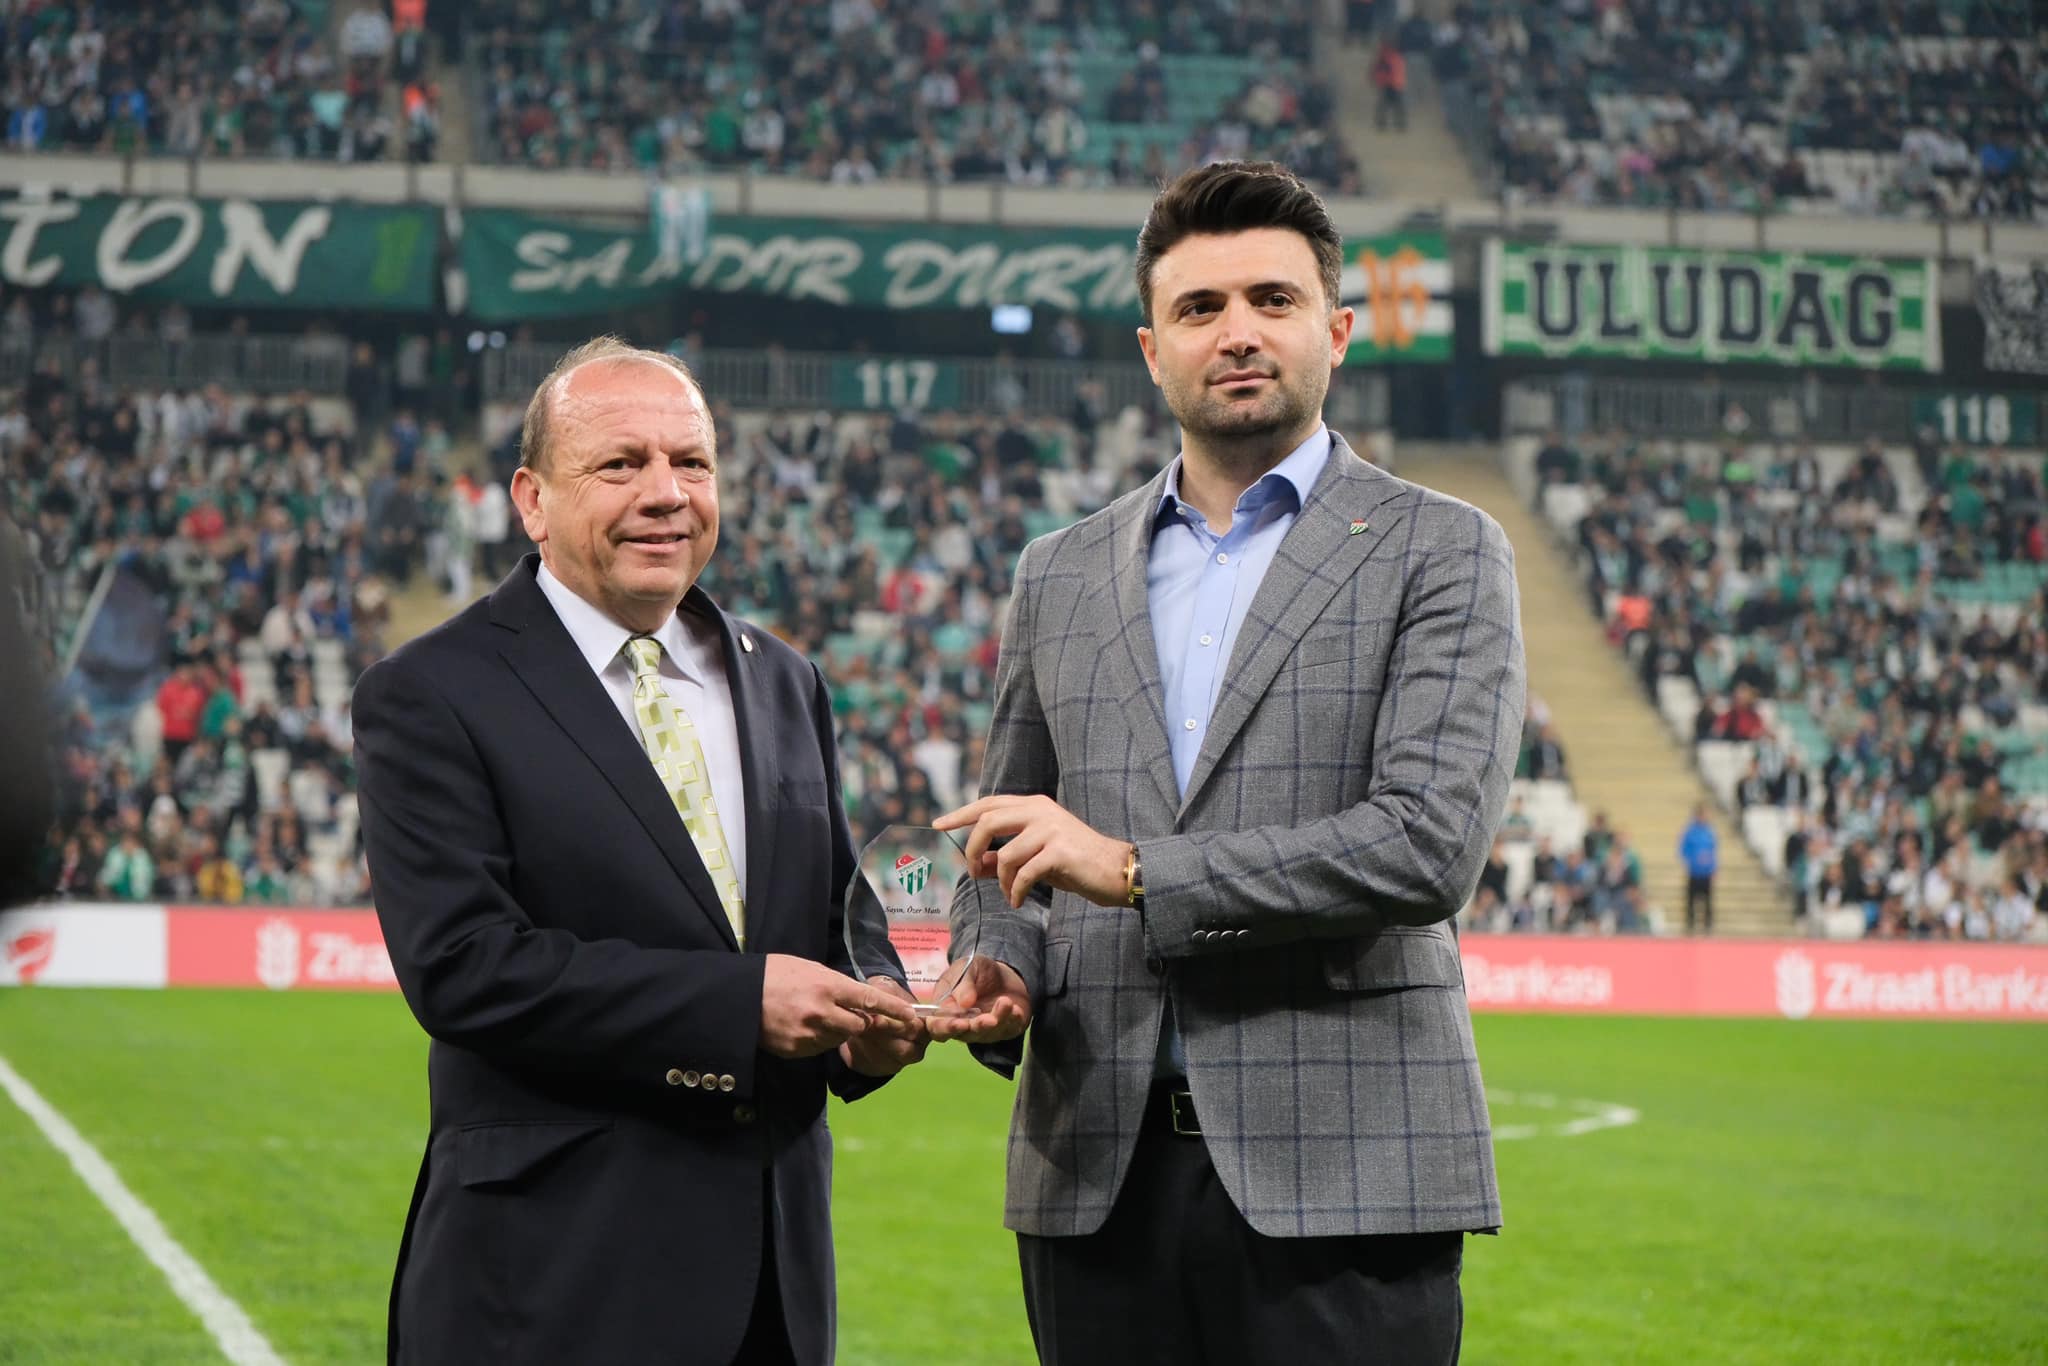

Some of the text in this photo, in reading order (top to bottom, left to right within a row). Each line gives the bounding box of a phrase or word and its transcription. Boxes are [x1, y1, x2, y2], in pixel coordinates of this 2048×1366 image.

[1533, 260, 1895, 350] ULUDAG
[856, 361, 937, 408] 117
[1938, 394, 2010, 444] 118
[1823, 962, 1938, 1012] Ziraat
